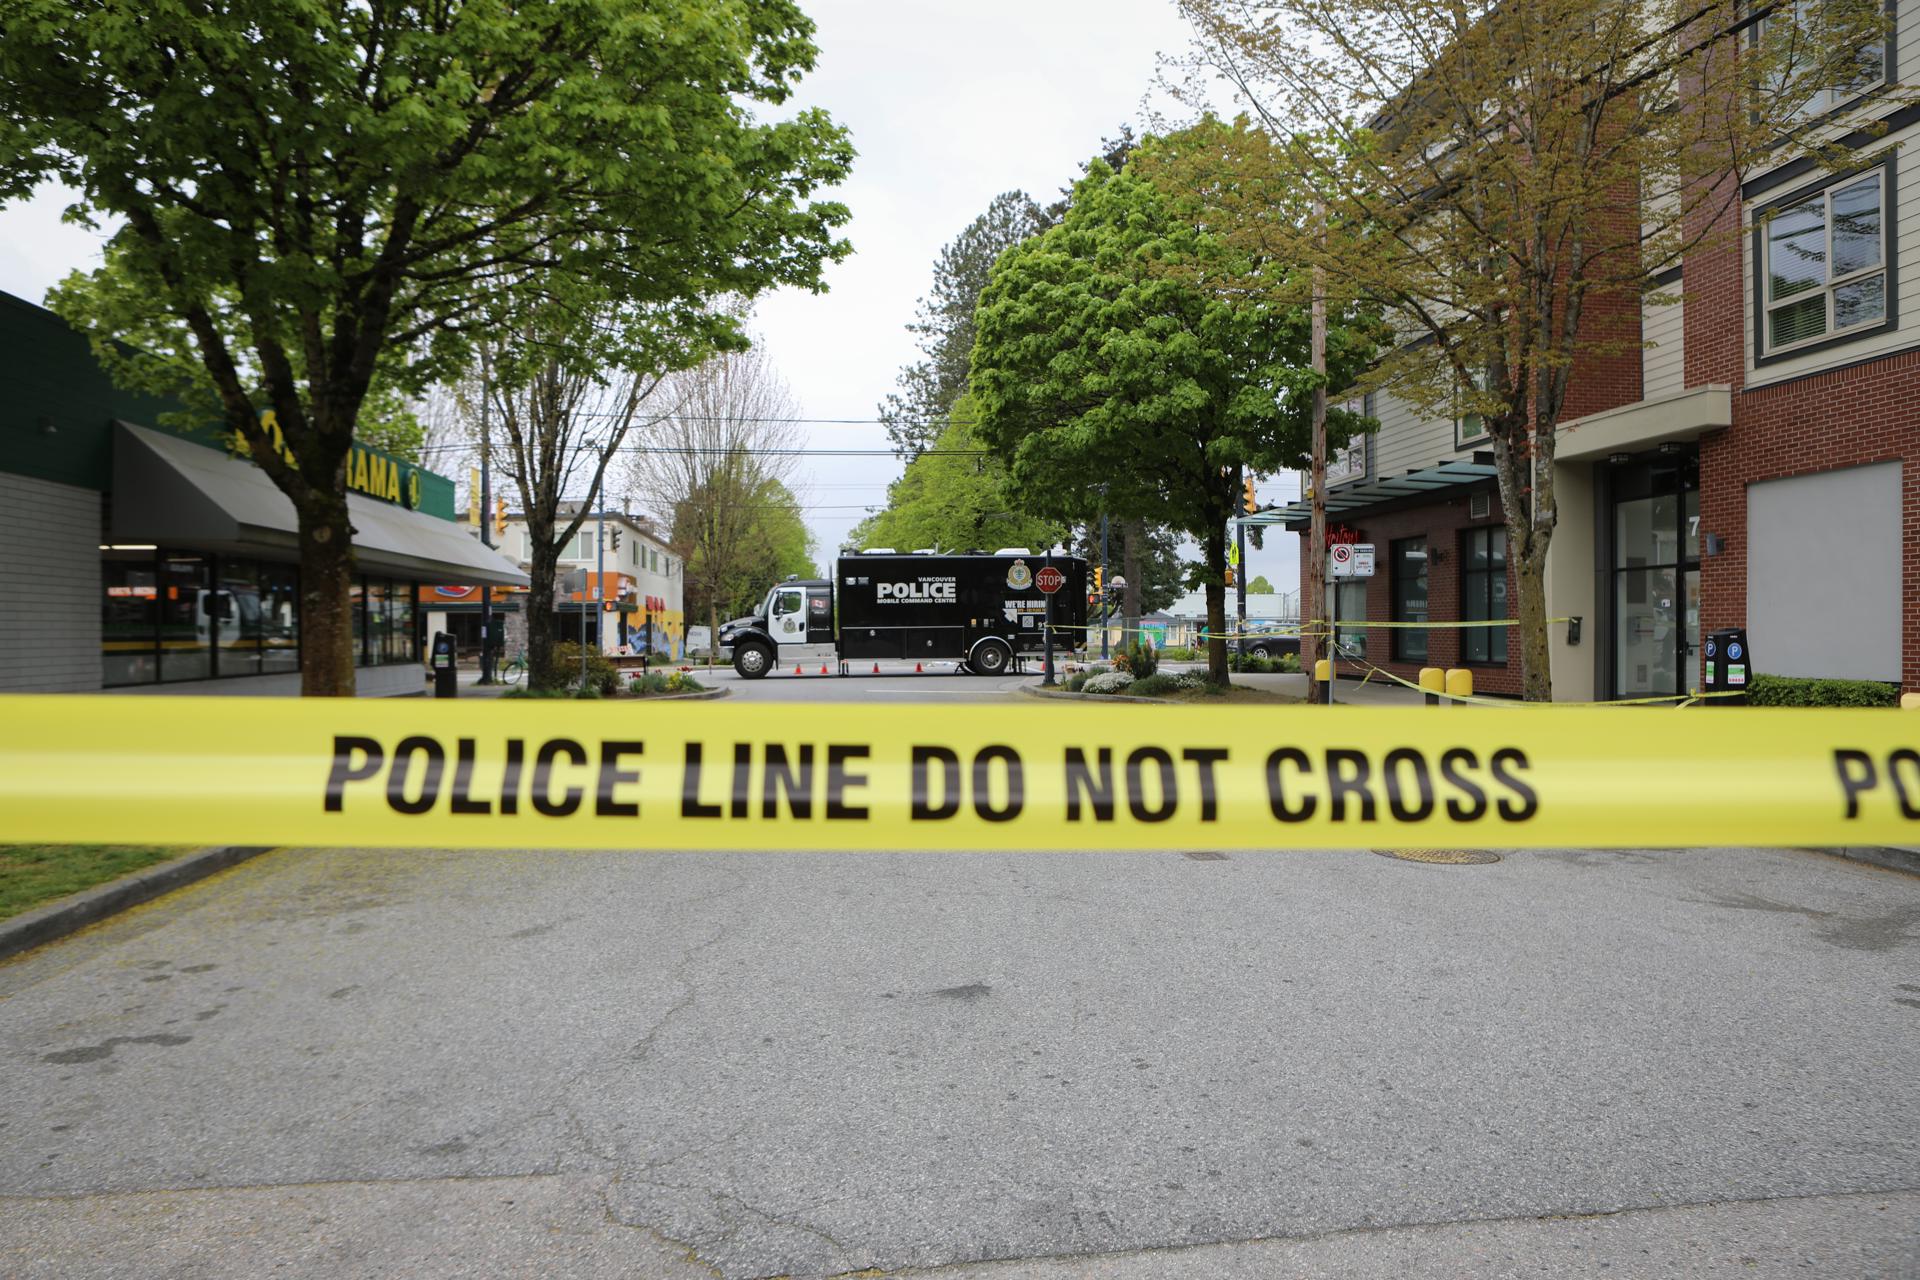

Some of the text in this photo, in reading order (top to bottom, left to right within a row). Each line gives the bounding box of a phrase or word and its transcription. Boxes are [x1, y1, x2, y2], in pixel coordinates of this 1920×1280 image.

[1037, 575, 1060, 586] STOP
[877, 582, 956, 598] POLICE
[1004, 600, 1046, 608] WE'RE HIRIN
[325, 736, 1537, 822] POLICE LINE DO NOT CROSS
